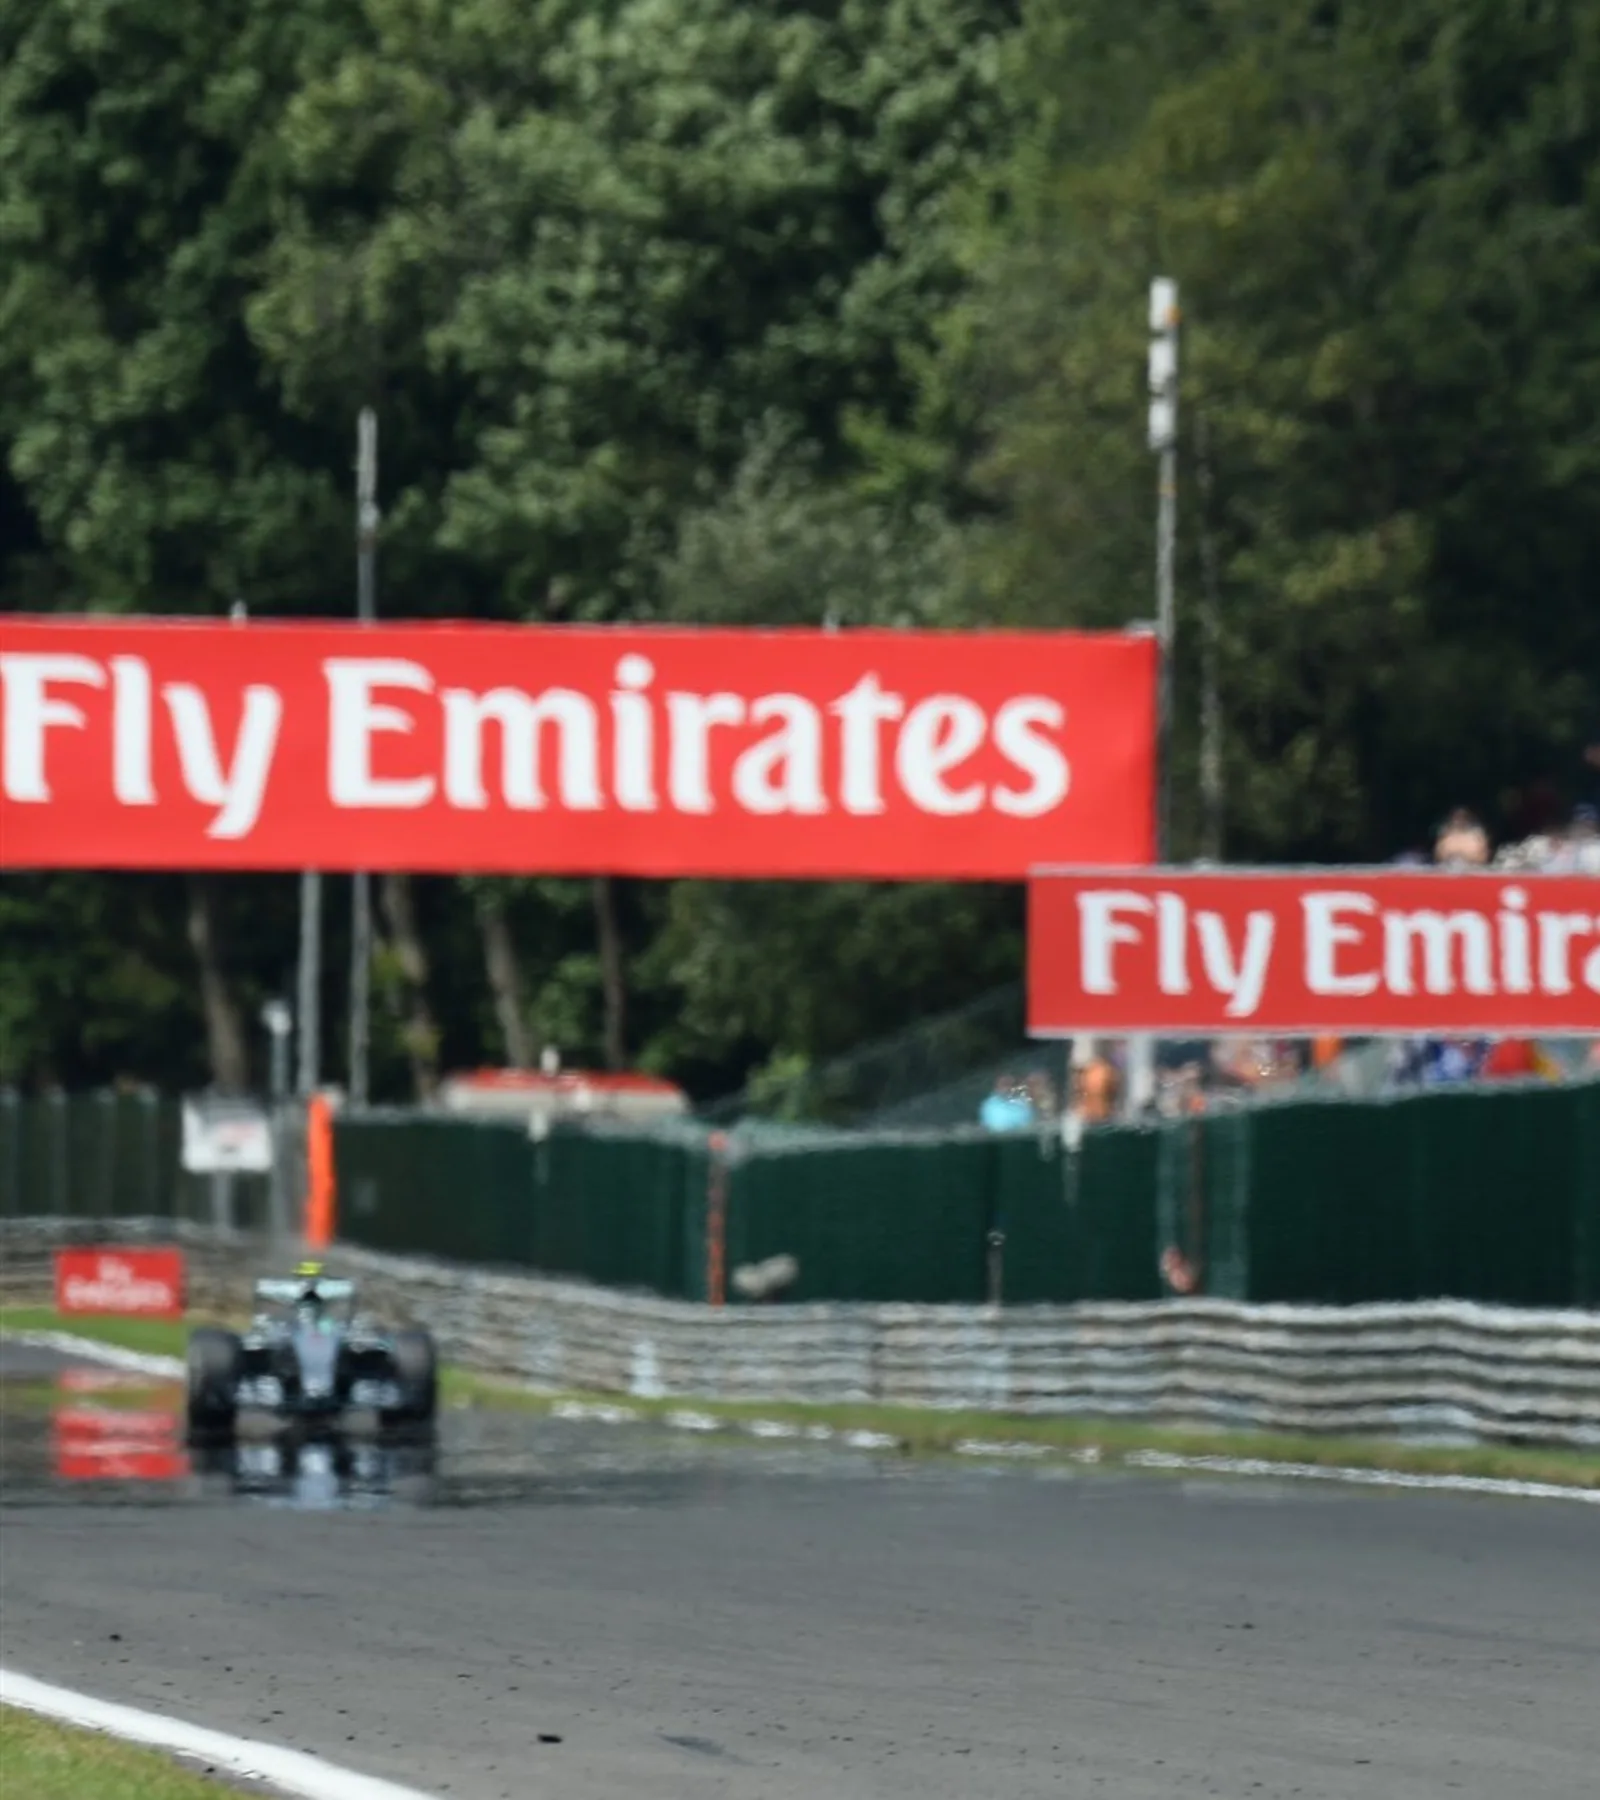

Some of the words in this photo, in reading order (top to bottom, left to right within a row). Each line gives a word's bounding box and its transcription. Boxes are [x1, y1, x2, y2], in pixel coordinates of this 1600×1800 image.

[0, 651, 282, 841] Fly
[322, 653, 1071, 819] Emirates
[1076, 889, 1275, 1018] Fly
